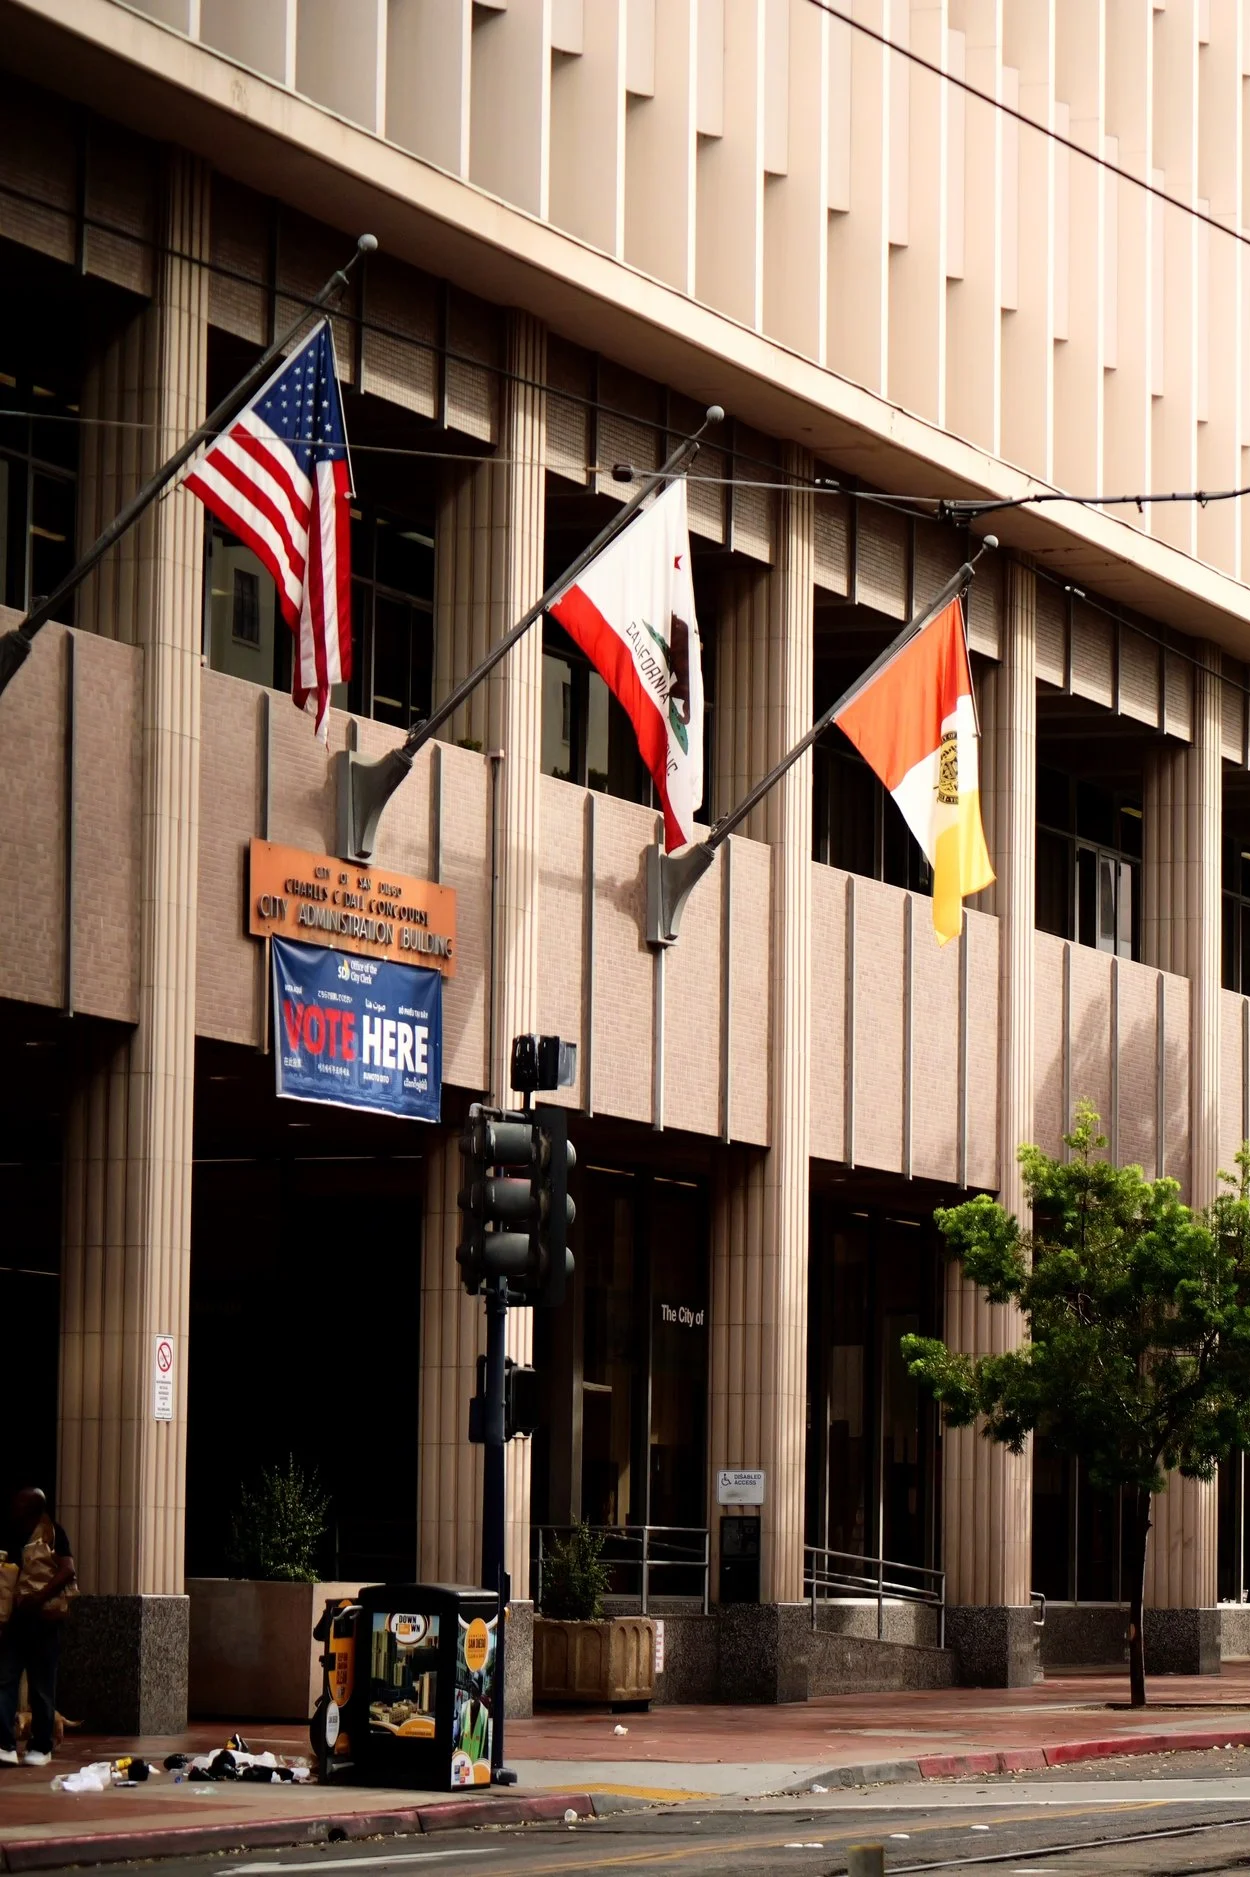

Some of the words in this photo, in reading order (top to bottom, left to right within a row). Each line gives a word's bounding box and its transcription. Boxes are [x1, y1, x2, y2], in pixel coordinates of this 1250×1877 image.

[626, 620, 669, 706] CALIFORNIA
[315, 866, 330, 880] CITY
[339, 872, 348, 885] OF
[358, 876, 372, 891] SAN
[379, 881, 402, 898] DIEGO
[259, 893, 289, 920] CITY
[298, 902, 394, 947] ADMINISTRATION
[401, 925, 453, 958] BUILDING
[370, 898, 428, 926] CONCOURSE
[350, 960, 364, 972] Office
[283, 999, 356, 1062] VOTE
[362, 1014, 428, 1075] HERE
[661, 1303, 677, 1322] The
[678, 1305, 694, 1328] City
[695, 1309, 704, 1326] of
[399, 1615, 417, 1623] DOWN
